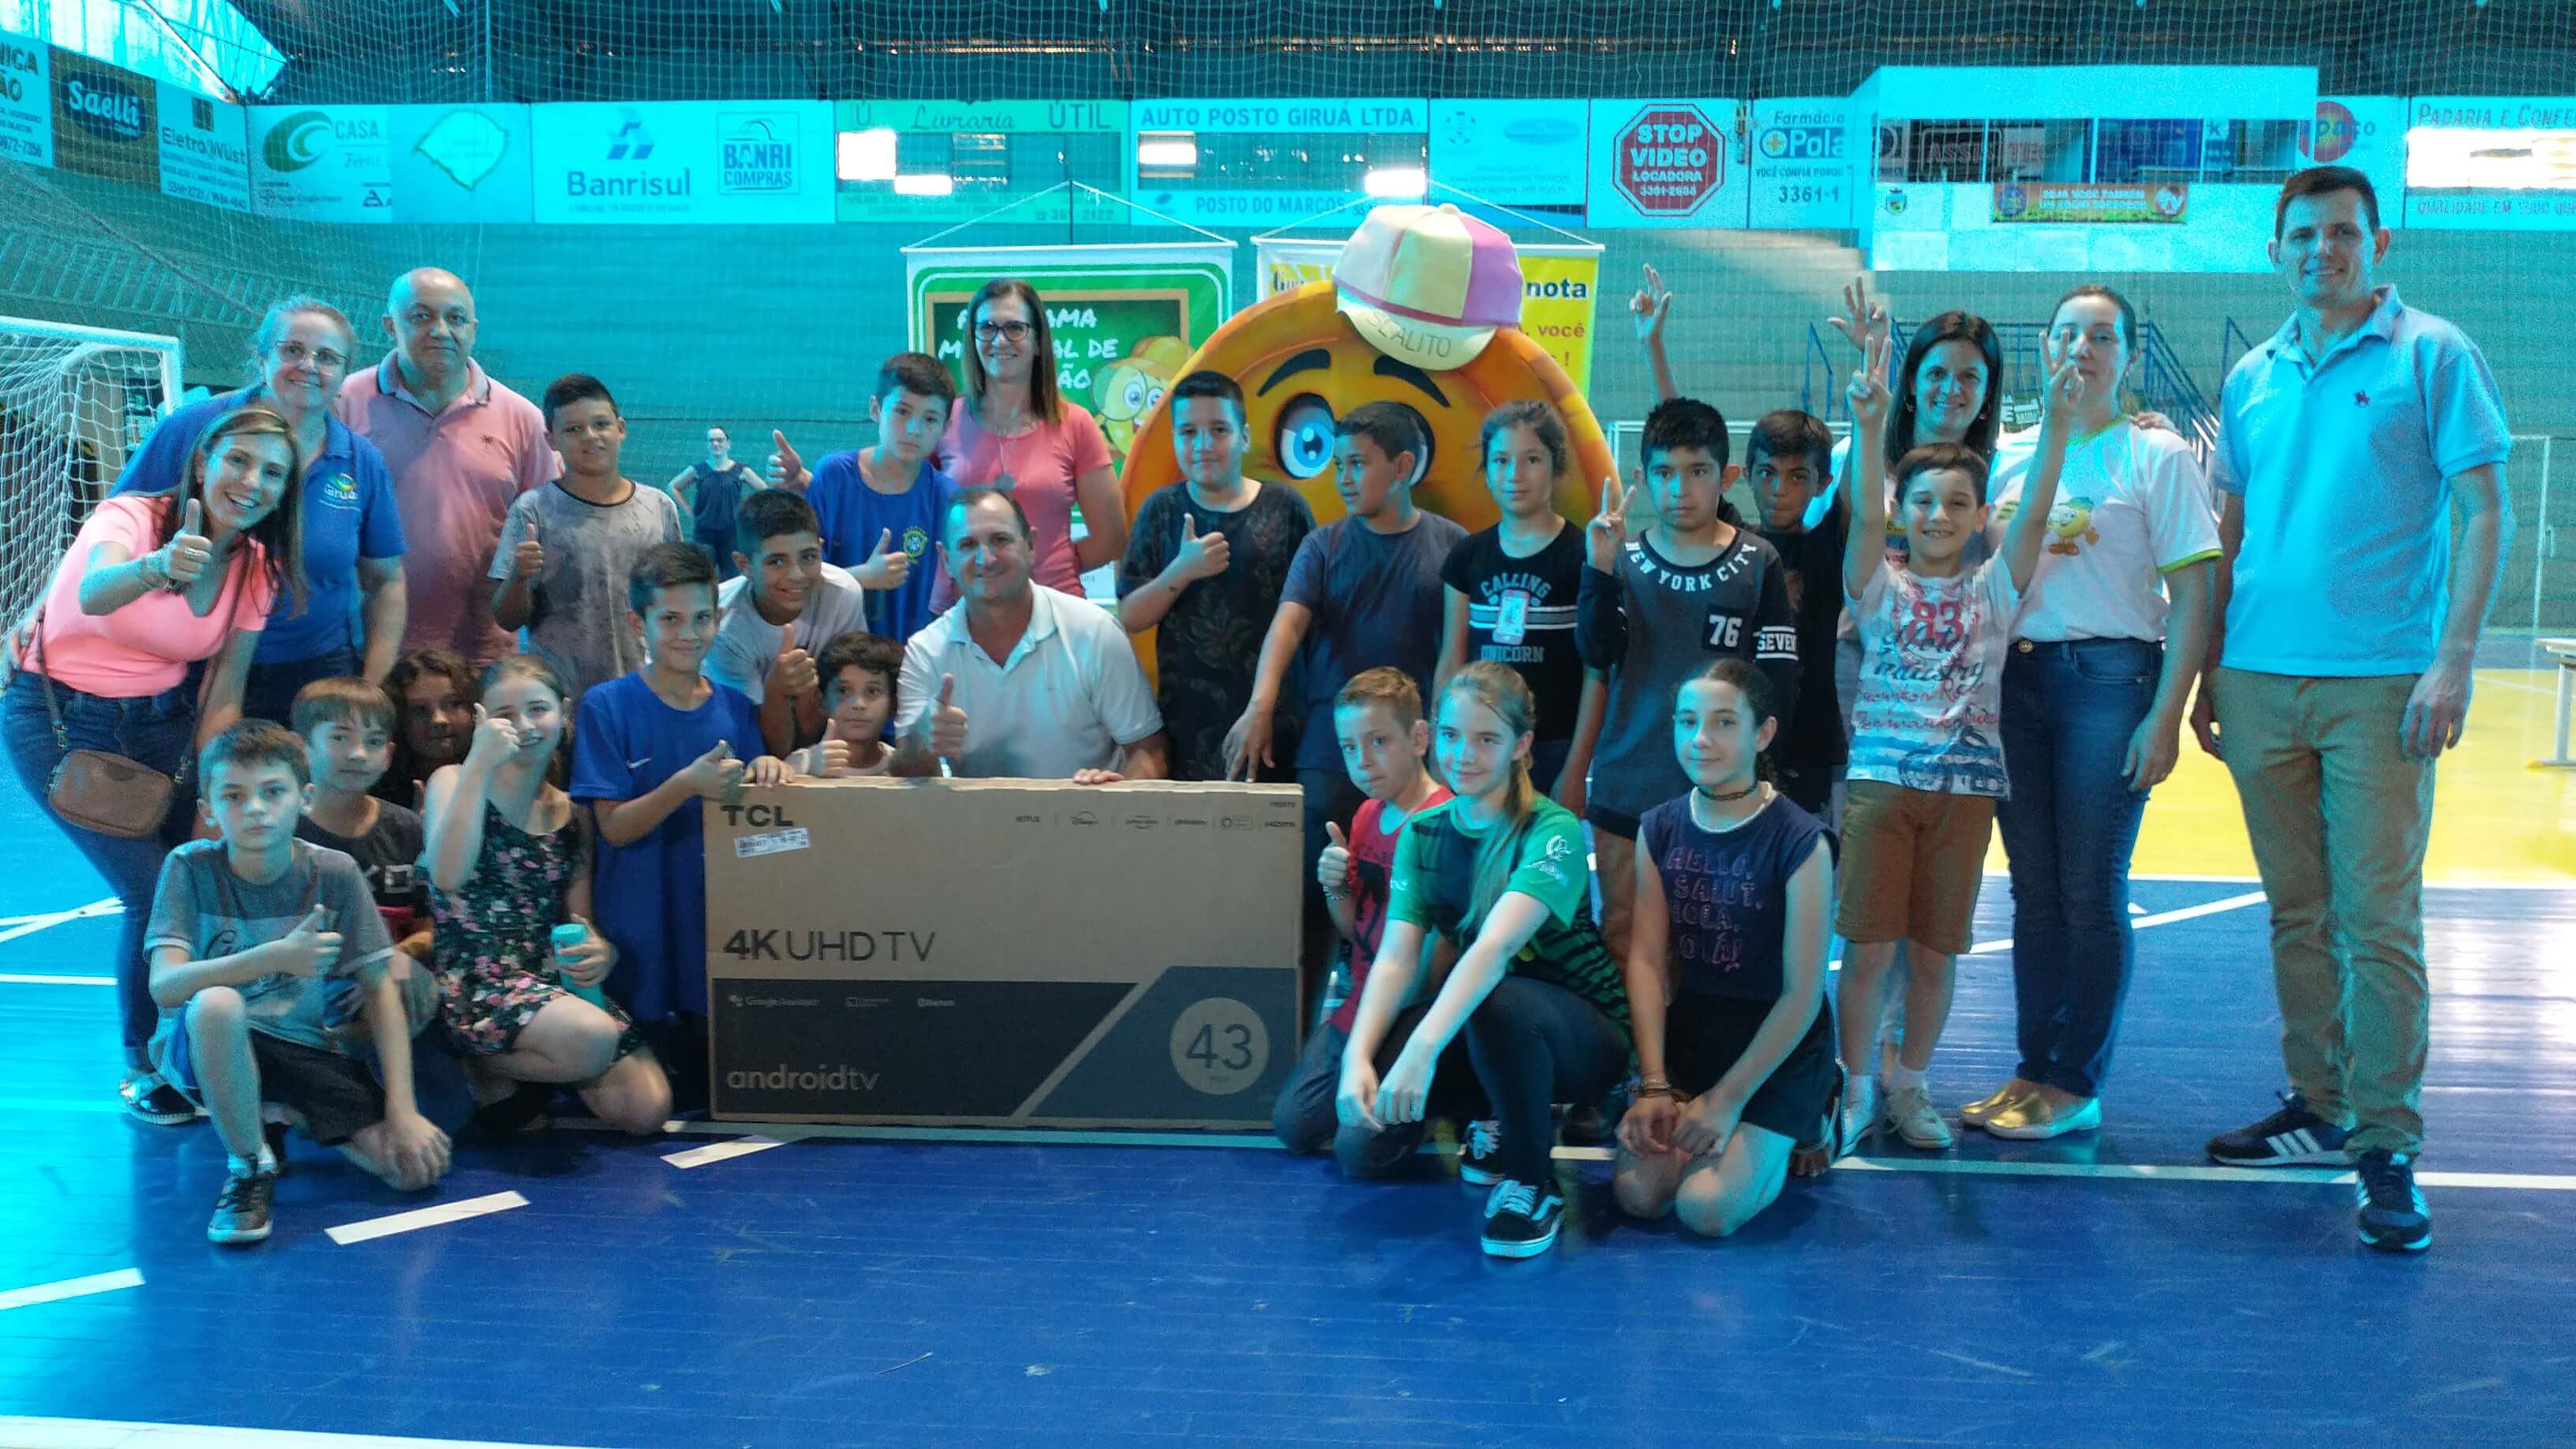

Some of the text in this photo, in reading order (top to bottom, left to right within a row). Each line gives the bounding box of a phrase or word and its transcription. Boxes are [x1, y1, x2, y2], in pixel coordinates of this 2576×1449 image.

[912, 104, 1016, 129] Livraria
[1048, 102, 1111, 129] ÚTIL
[1141, 107, 1200, 126] AUTO
[1208, 107, 1279, 126] POSTO
[1287, 101, 1352, 126] GIRUÁ
[335, 120, 380, 139] CASA
[1637, 124, 1703, 144] STOP
[723, 143, 792, 169] BANRI
[1630, 148, 1708, 167] VIDEO
[567, 167, 691, 197] Banrisul
[723, 170, 792, 186] COMPRAS
[1632, 170, 1703, 182] LOCADORA
[1195, 196, 1249, 215] POSTO
[1252, 196, 1274, 215] DO
[1526, 277, 1587, 298] nota
[1537, 322, 1586, 338] você
[1624, 541, 1758, 592] NEW YORK CITY
[1480, 572, 1552, 598] CALLING
[1708, 613, 1743, 648] 76
[1481, 644, 1545, 664] UNICORN
[720, 803, 795, 828] TCL
[722, 928, 938, 962] 4K UHD TV
[1185, 1023, 1252, 1071] 43
